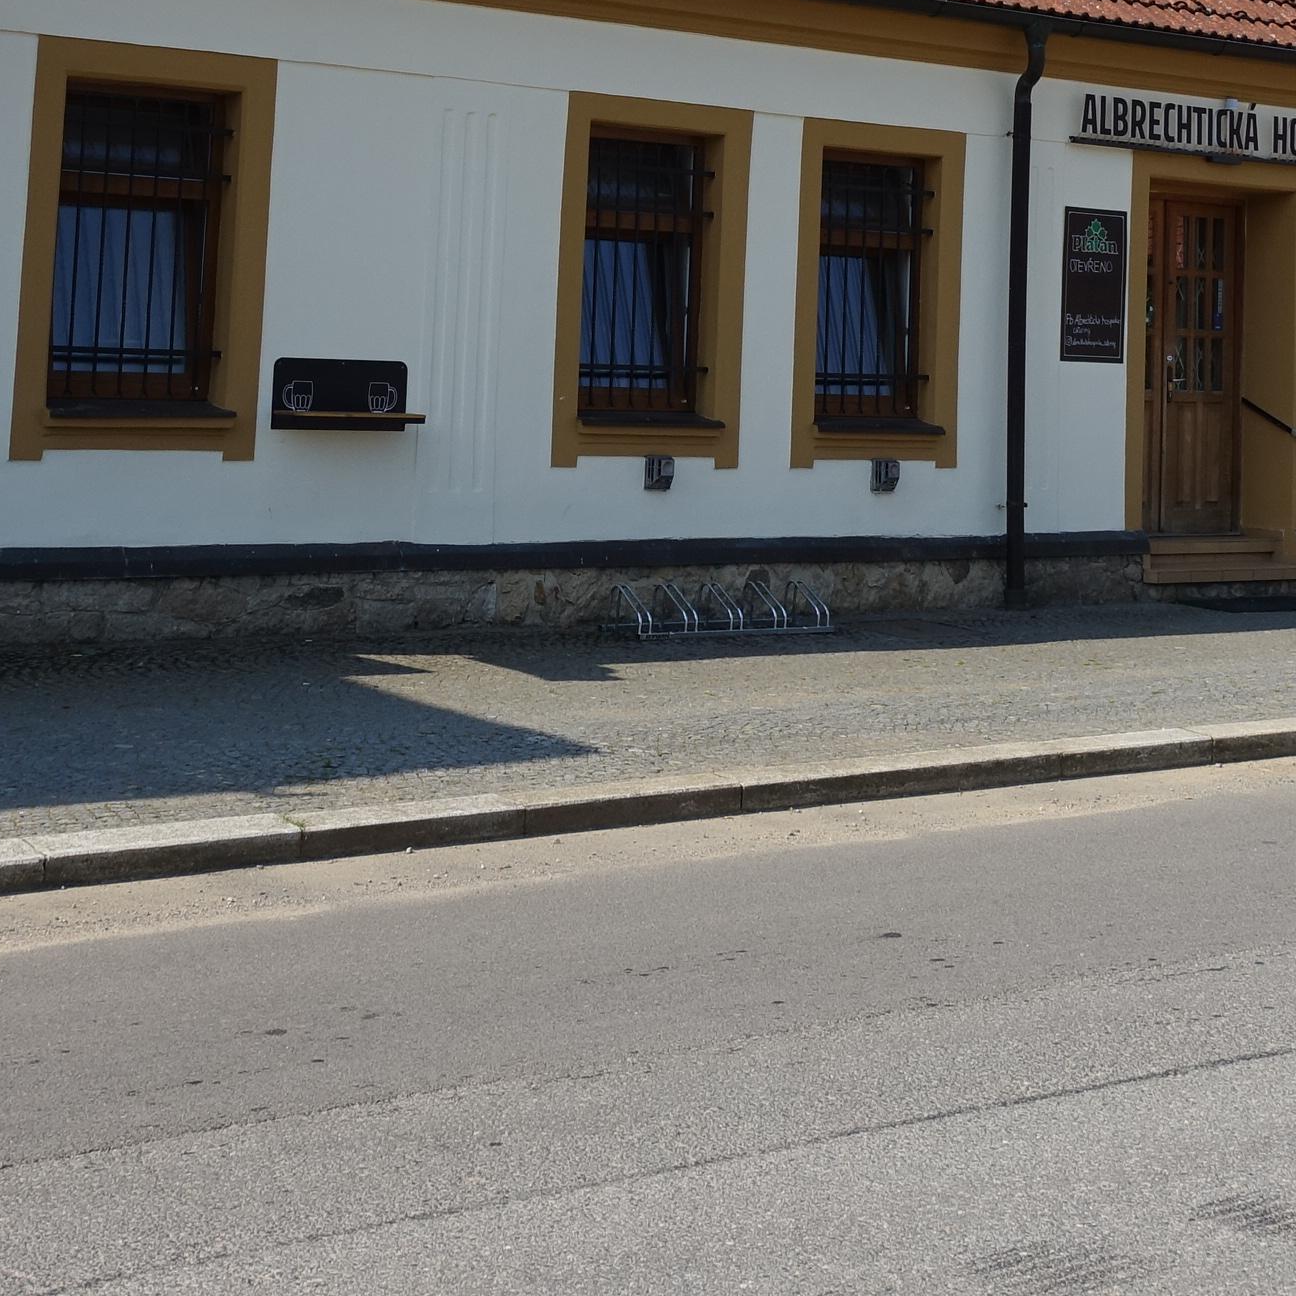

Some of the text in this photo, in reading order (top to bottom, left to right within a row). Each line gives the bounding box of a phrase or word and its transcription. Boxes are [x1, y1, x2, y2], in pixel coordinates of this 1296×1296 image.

[1081, 93, 1259, 152] ALBRECHTICKÁ
[1071, 234, 1119, 255] Platan
[1069, 257, 1113, 273] OTEVŘENO
